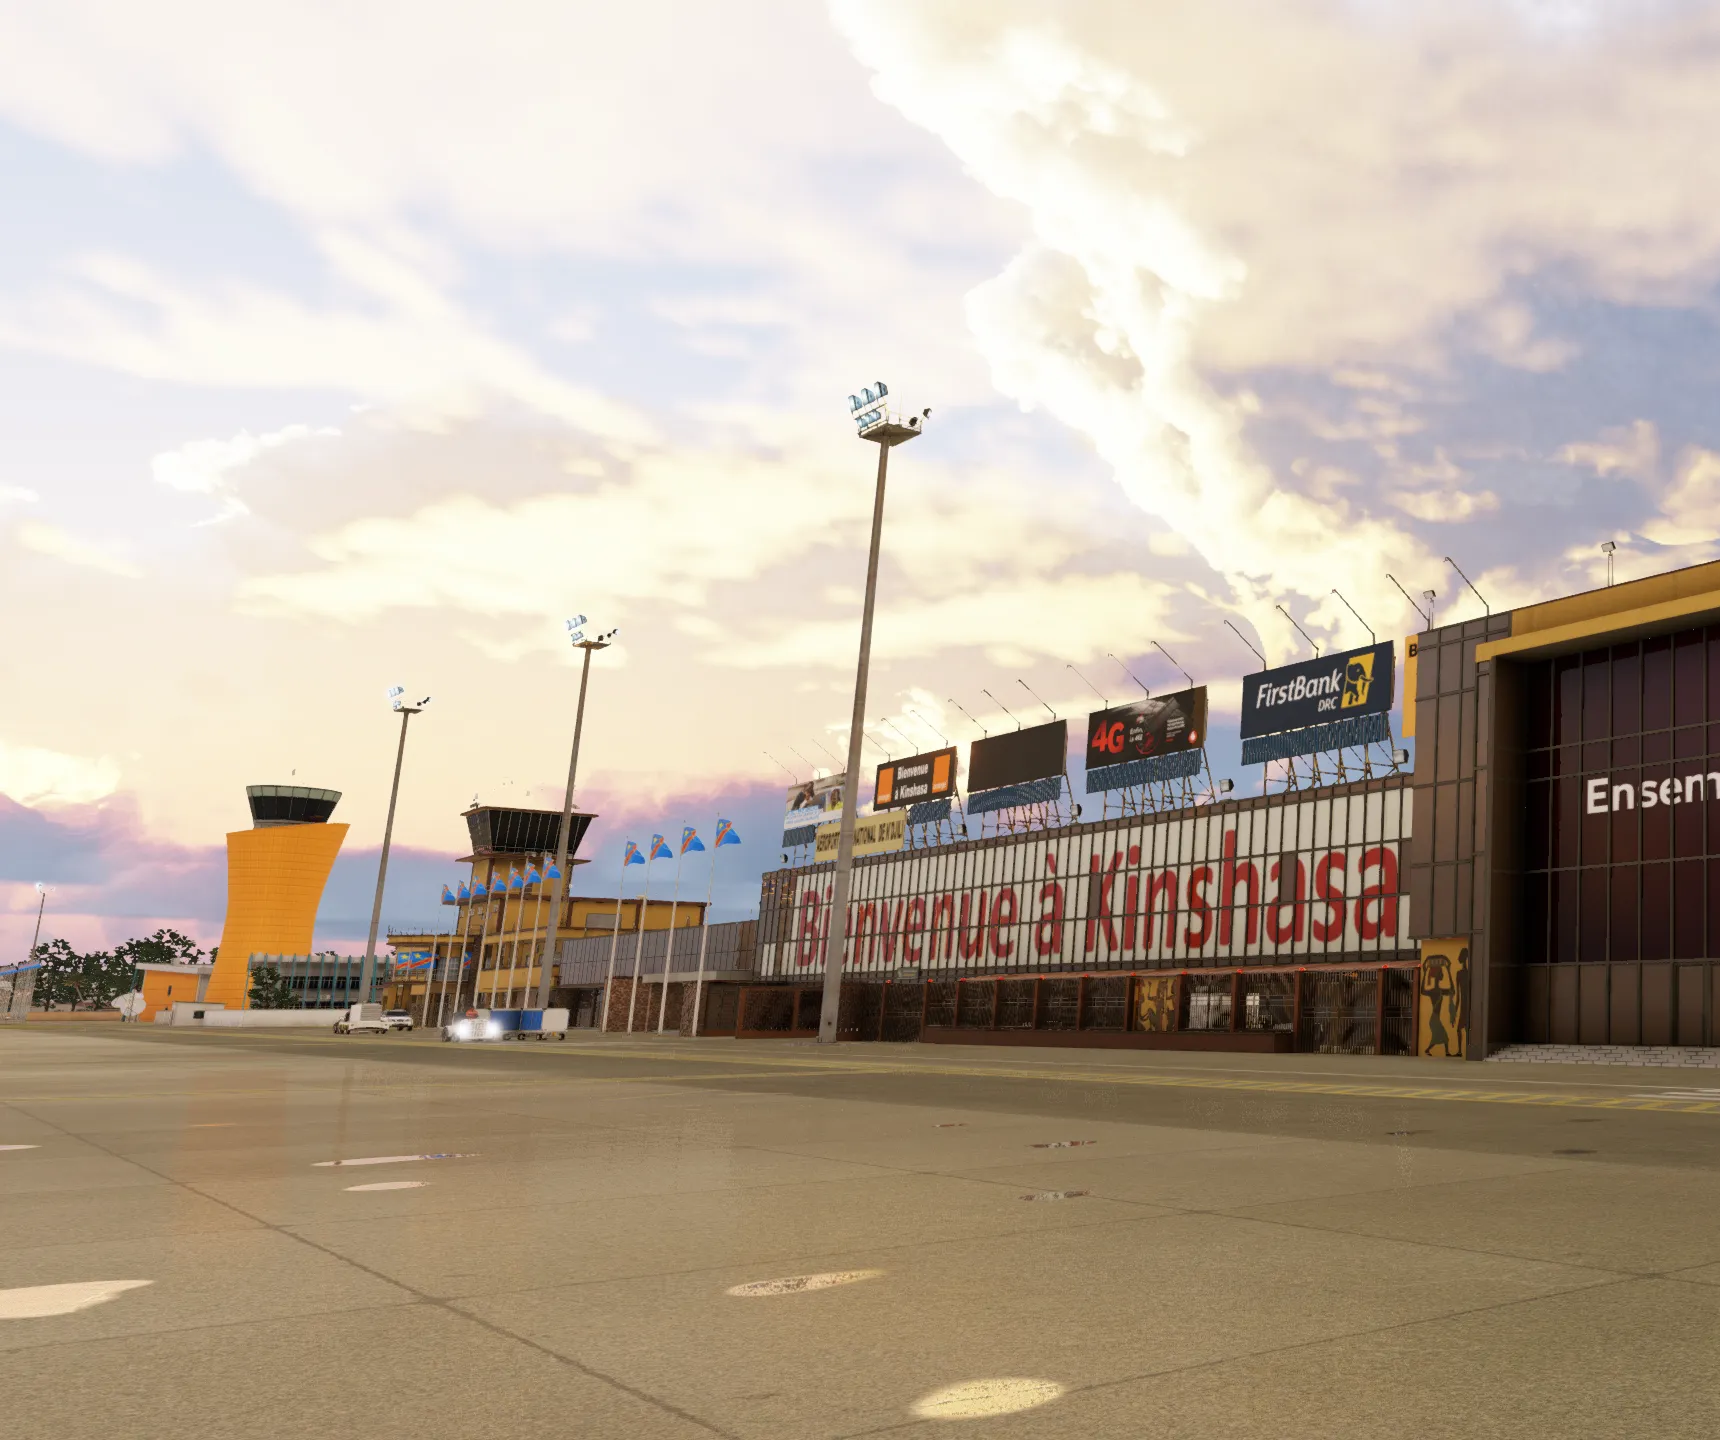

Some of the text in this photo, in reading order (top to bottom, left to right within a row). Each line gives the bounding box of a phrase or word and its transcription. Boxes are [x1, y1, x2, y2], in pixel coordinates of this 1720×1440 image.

[1255, 668, 1343, 709] FirstBank
[1317, 696, 1339, 712] DRC
[1091, 720, 1124, 754] 4G
[897, 763, 929, 780] Bienvenue
[899, 782, 929, 799] Kinshasa
[797, 829, 1398, 967] Binvenue à Kinshasa
